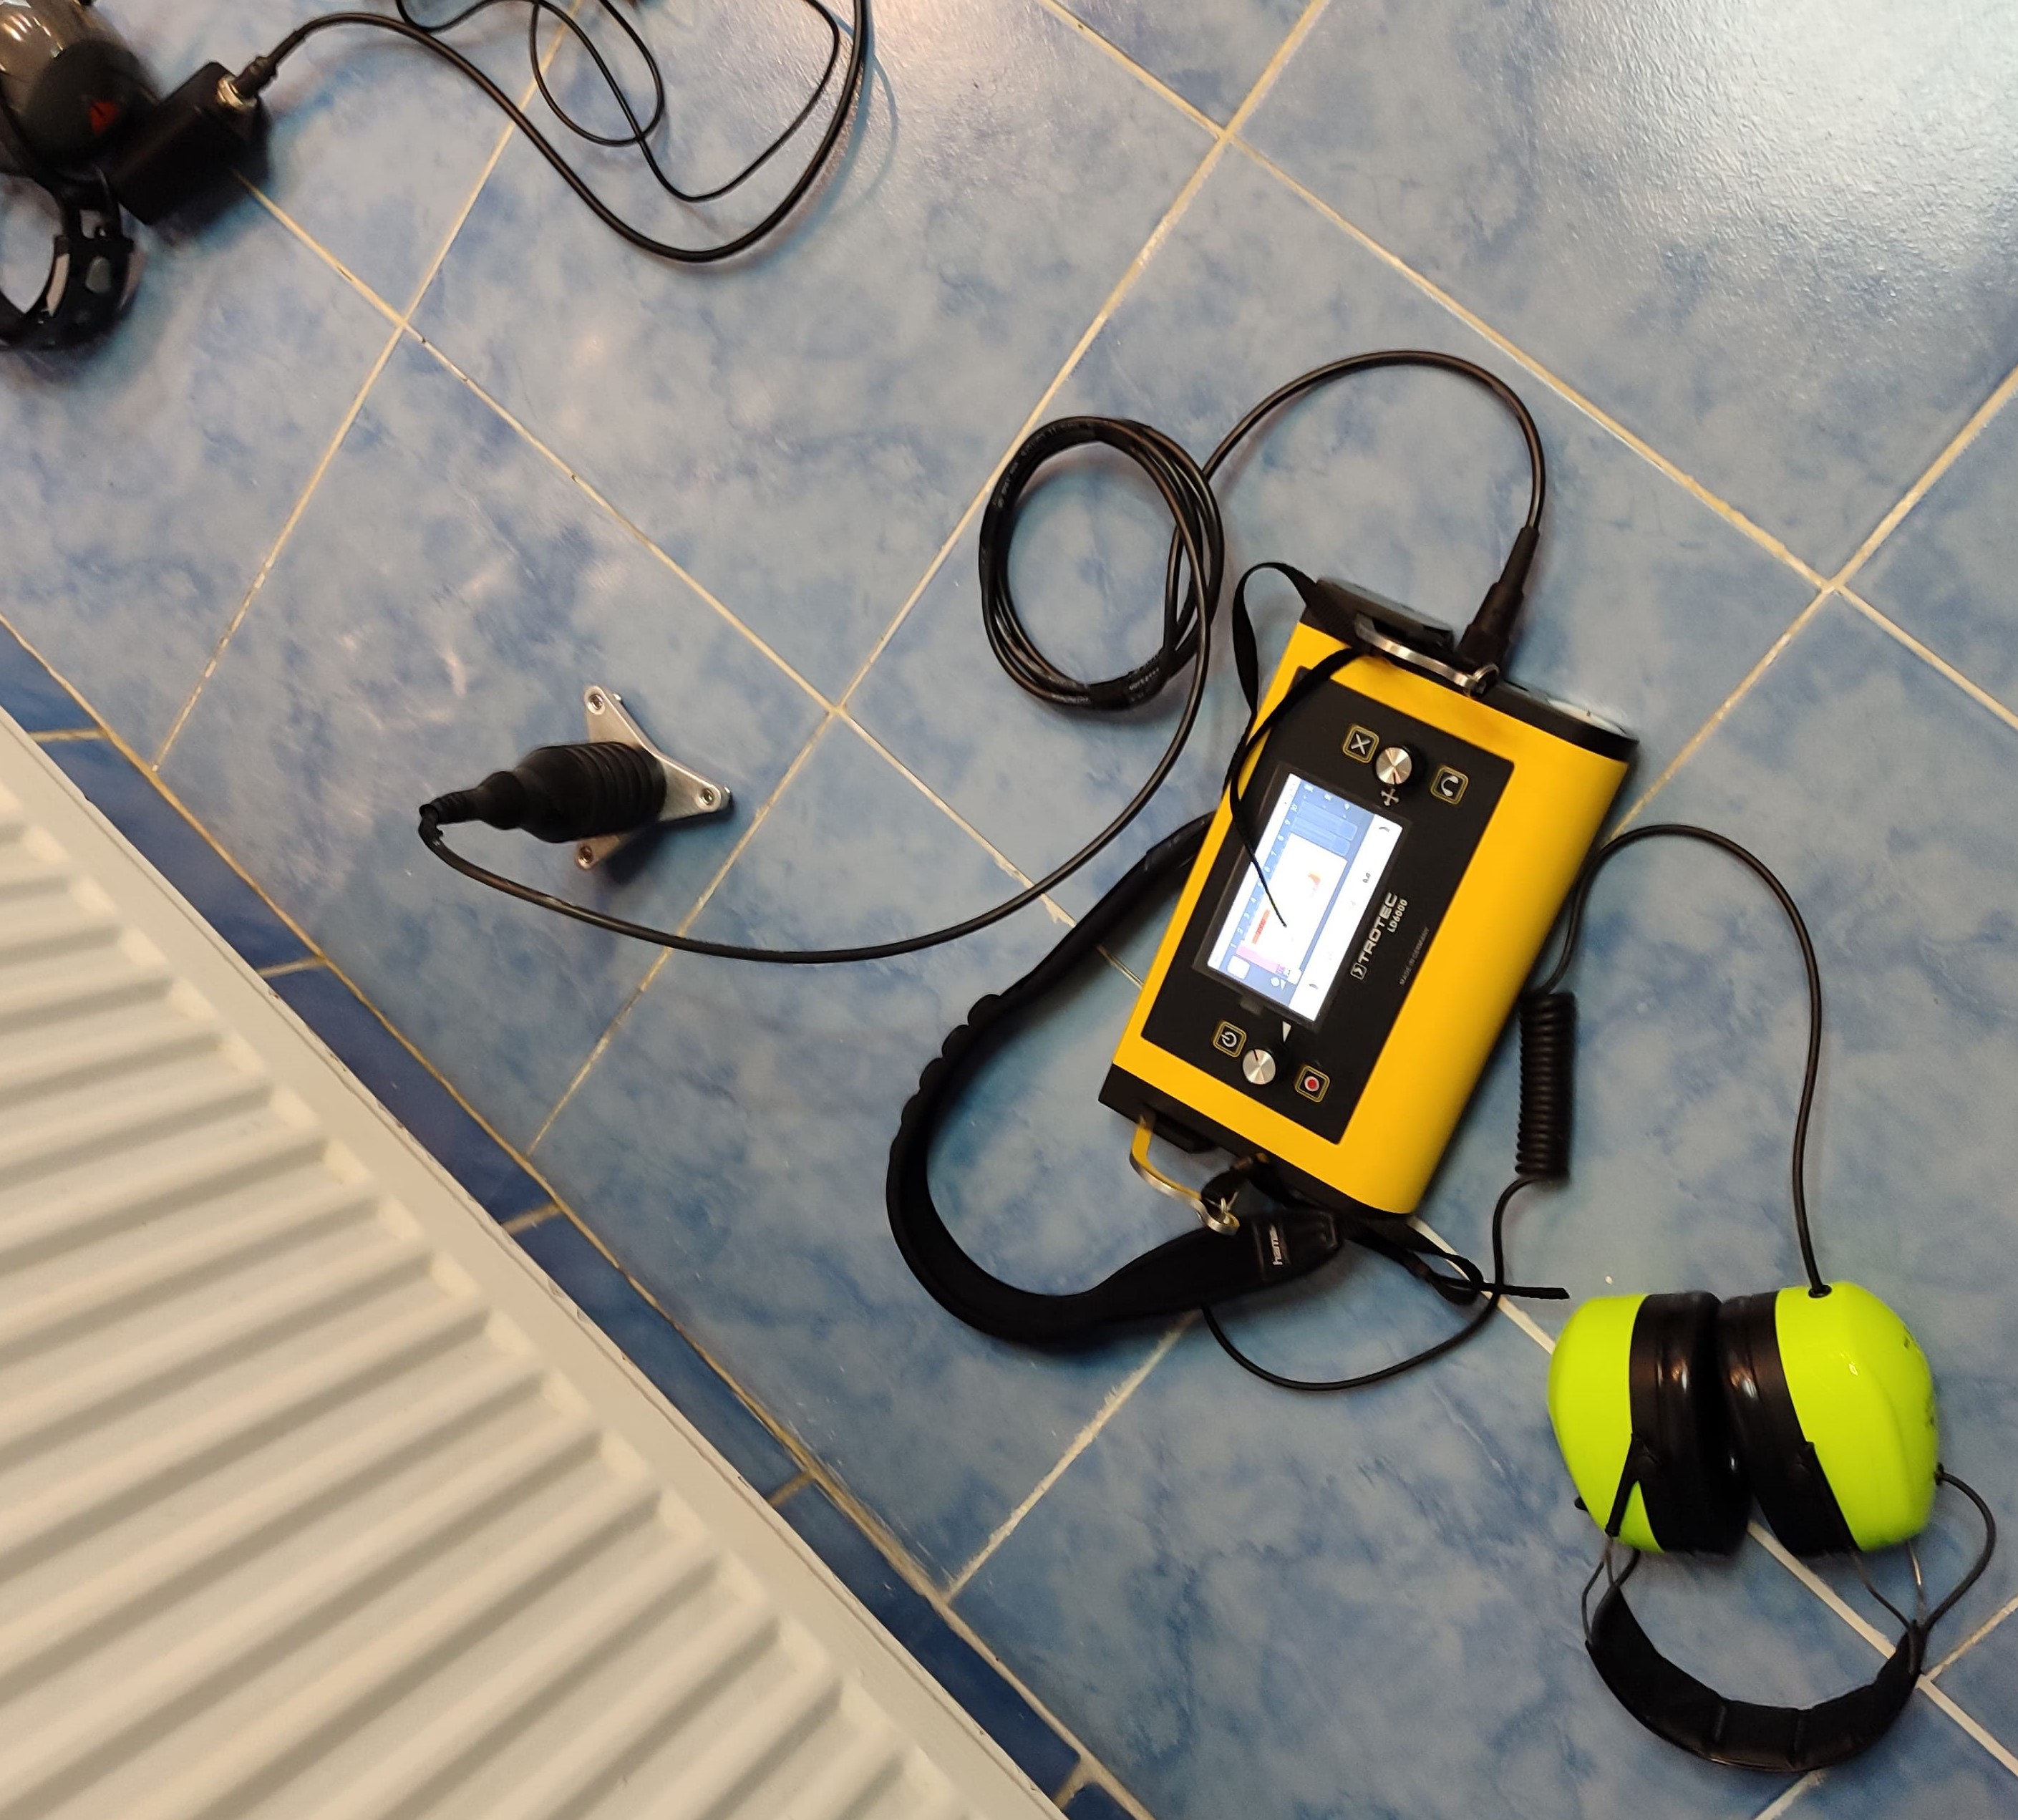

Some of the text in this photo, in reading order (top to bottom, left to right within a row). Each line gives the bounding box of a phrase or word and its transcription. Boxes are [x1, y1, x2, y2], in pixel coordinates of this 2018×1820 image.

[1357, 891, 1398, 963] TROTEC
[1387, 898, 1408, 933] LD6000
[1399, 966, 1412, 985] MADE
[1412, 926, 1430, 959] GERMANY
